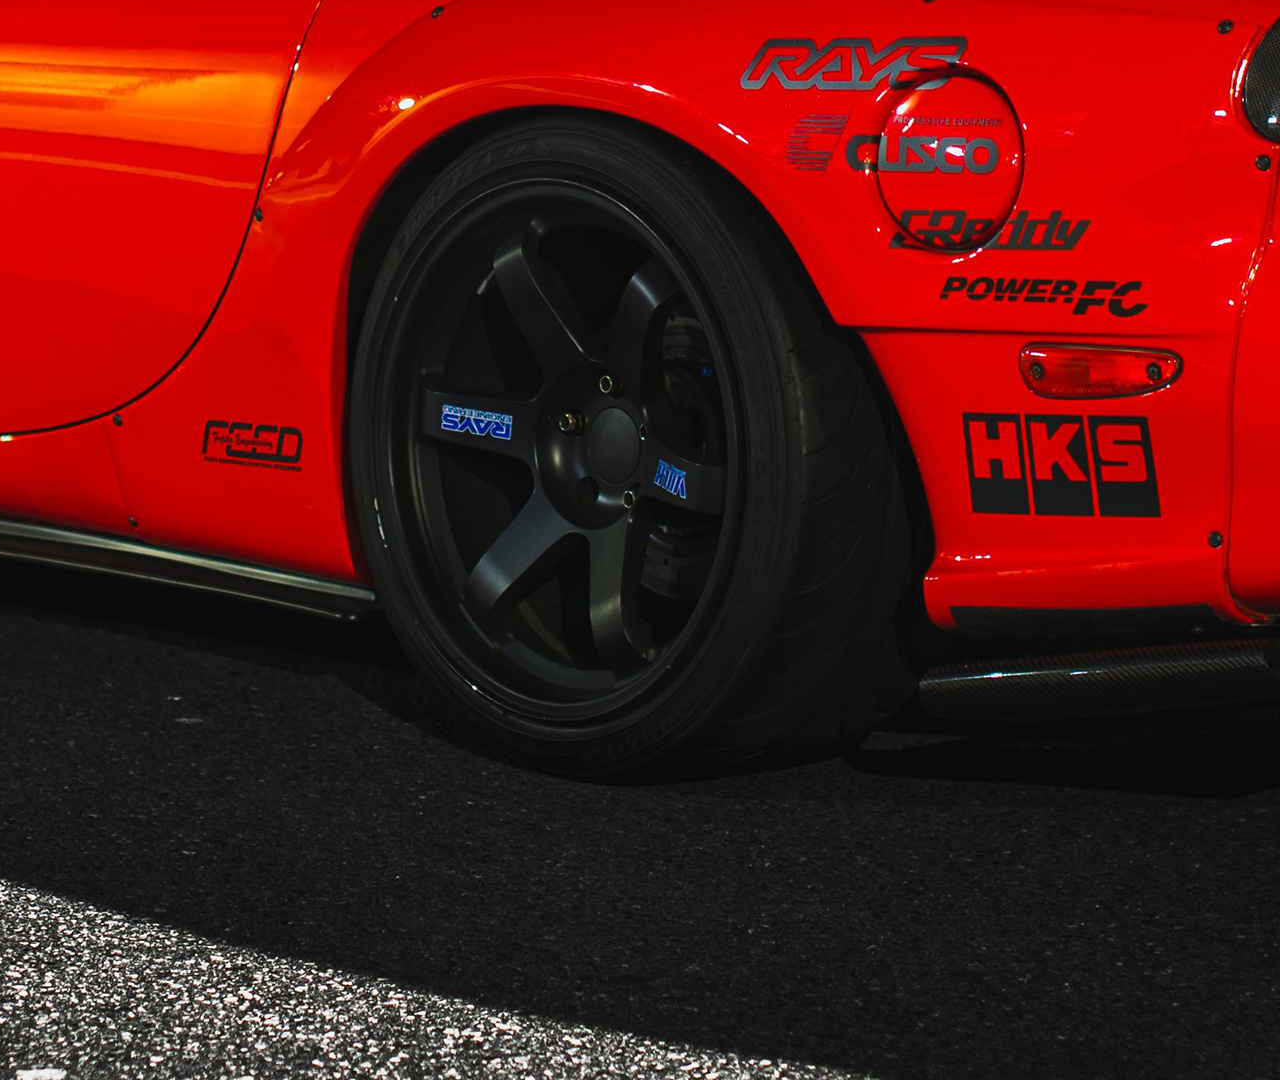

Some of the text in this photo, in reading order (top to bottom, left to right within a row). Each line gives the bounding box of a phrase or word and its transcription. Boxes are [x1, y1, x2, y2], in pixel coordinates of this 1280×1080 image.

[740, 36, 968, 90] RAYS
[846, 135, 999, 174] CUSCO
[889, 210, 1091, 252] GReddy
[441, 412, 512, 440] RAYS
[442, 405, 512, 424] ENGINEERING
[966, 417, 1150, 486] HKS
